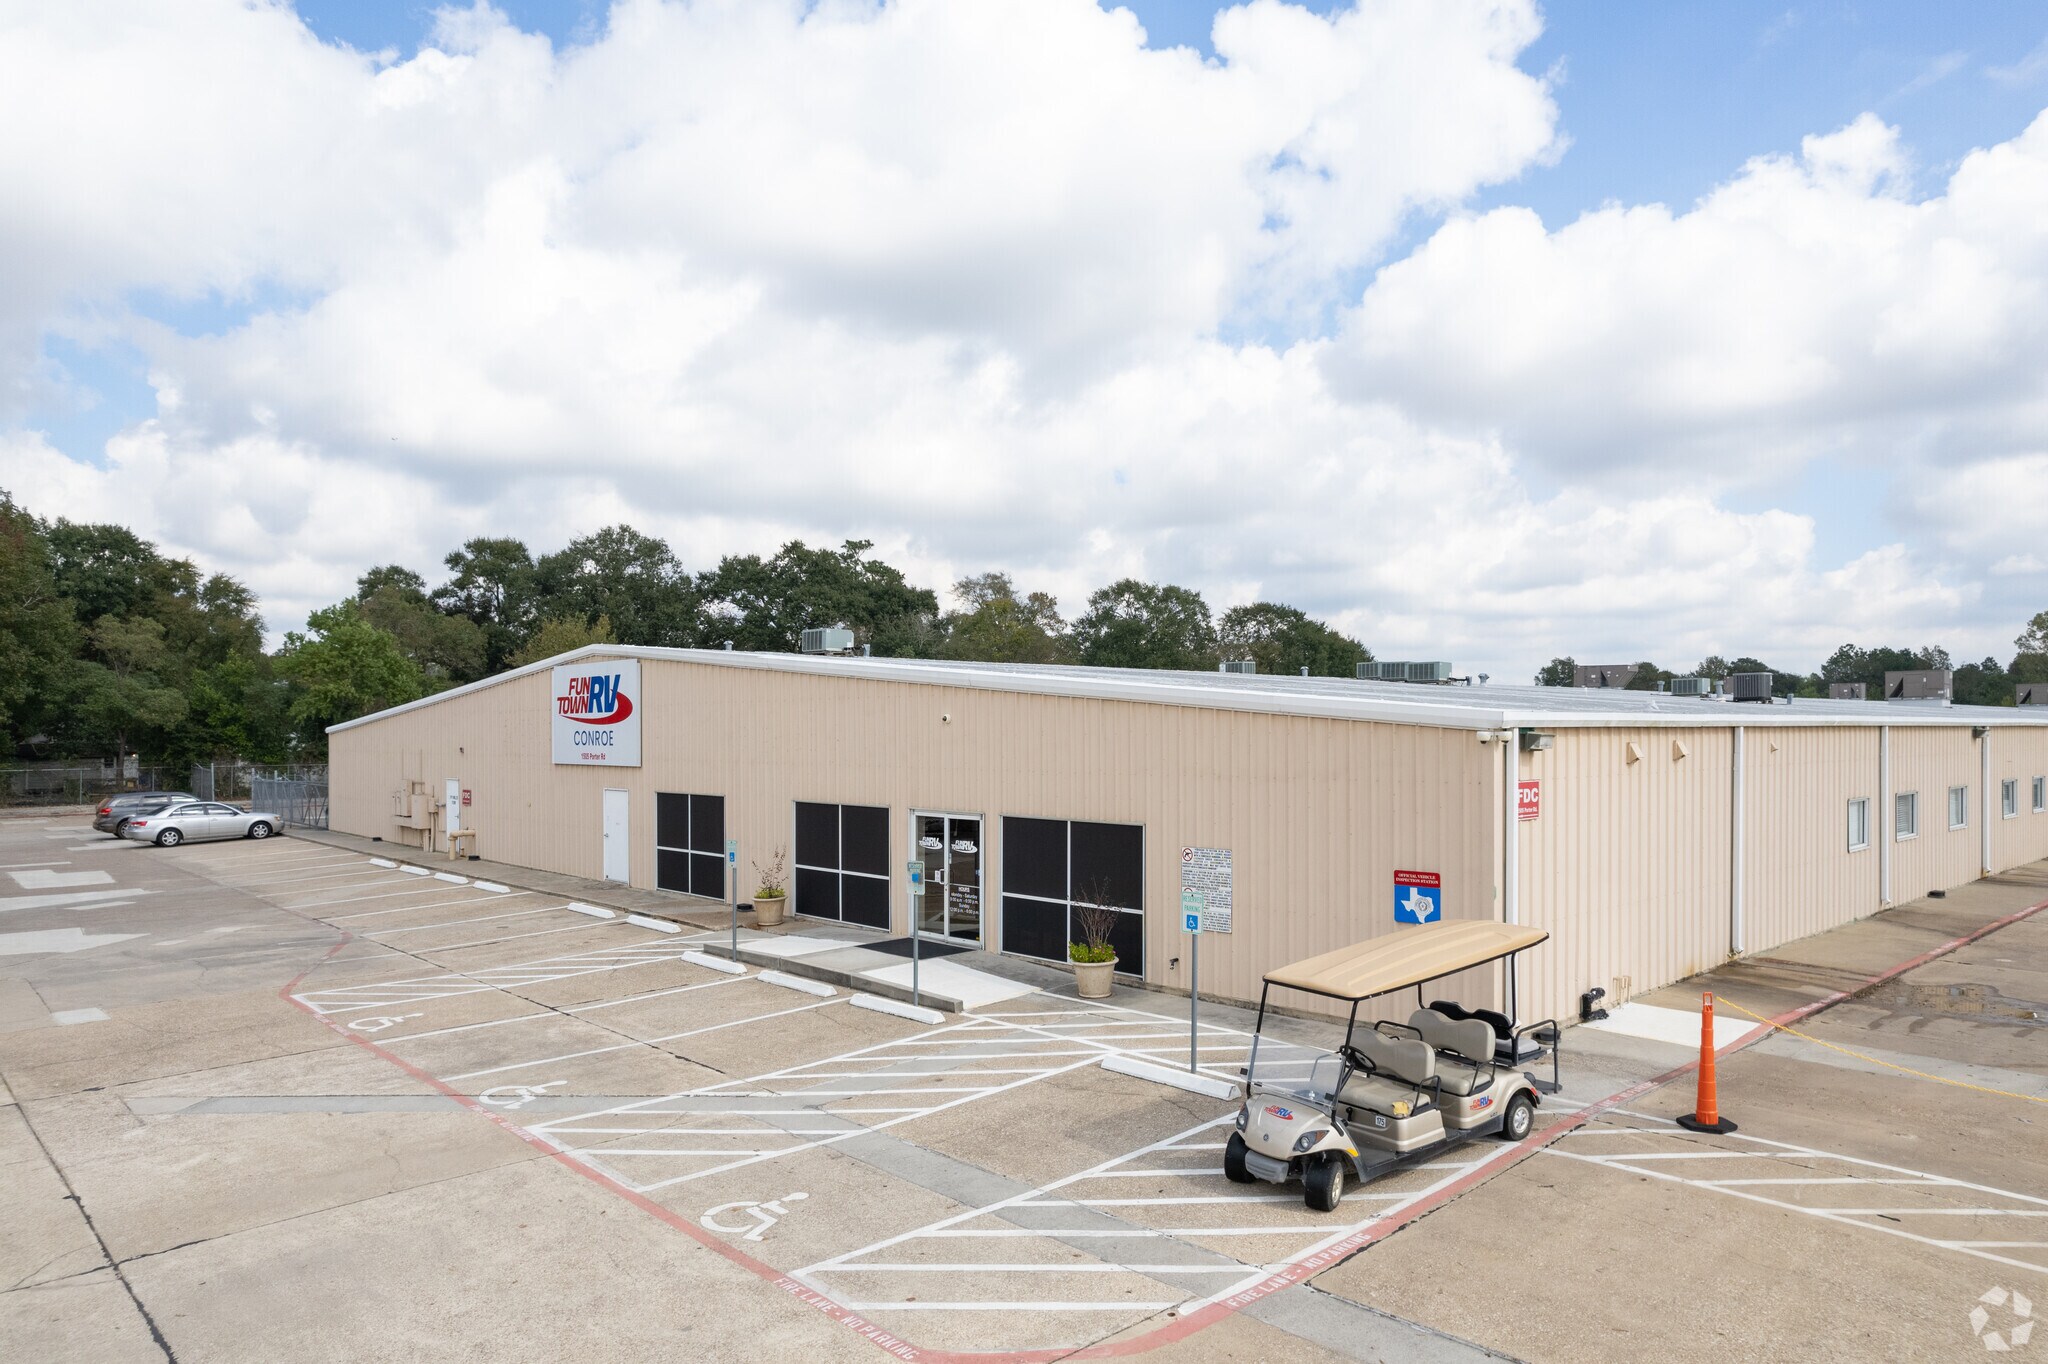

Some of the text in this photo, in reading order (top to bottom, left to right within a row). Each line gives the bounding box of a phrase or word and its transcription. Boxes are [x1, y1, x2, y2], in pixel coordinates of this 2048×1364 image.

[568, 676, 591, 695] FUN
[588, 674, 621, 713] RV
[557, 695, 589, 715] TOWN
[573, 730, 614, 746] CONROE
[1517, 787, 1539, 803] FDC
[928, 837, 940, 847] RV
[961, 840, 974, 850] RV
[1183, 895, 1202, 903] RESERVED
[1184, 905, 1200, 913] PARKING
[1479, 1095, 1489, 1106] RV
[1276, 1107, 1293, 1117] RV
[1376, 1116, 1385, 1126] 175
[1227, 1289, 1263, 1307] FIRE
[1260, 1272, 1297, 1293] LANE
[1302, 1256, 1322, 1269] NO
[1322, 1232, 1372, 1259] PARKING
[774, 1277, 803, 1295] FIRE
[799, 1291, 838, 1313] LANE
[840, 1315, 864, 1329] NO
[858, 1325, 920, 1360] PARKING
